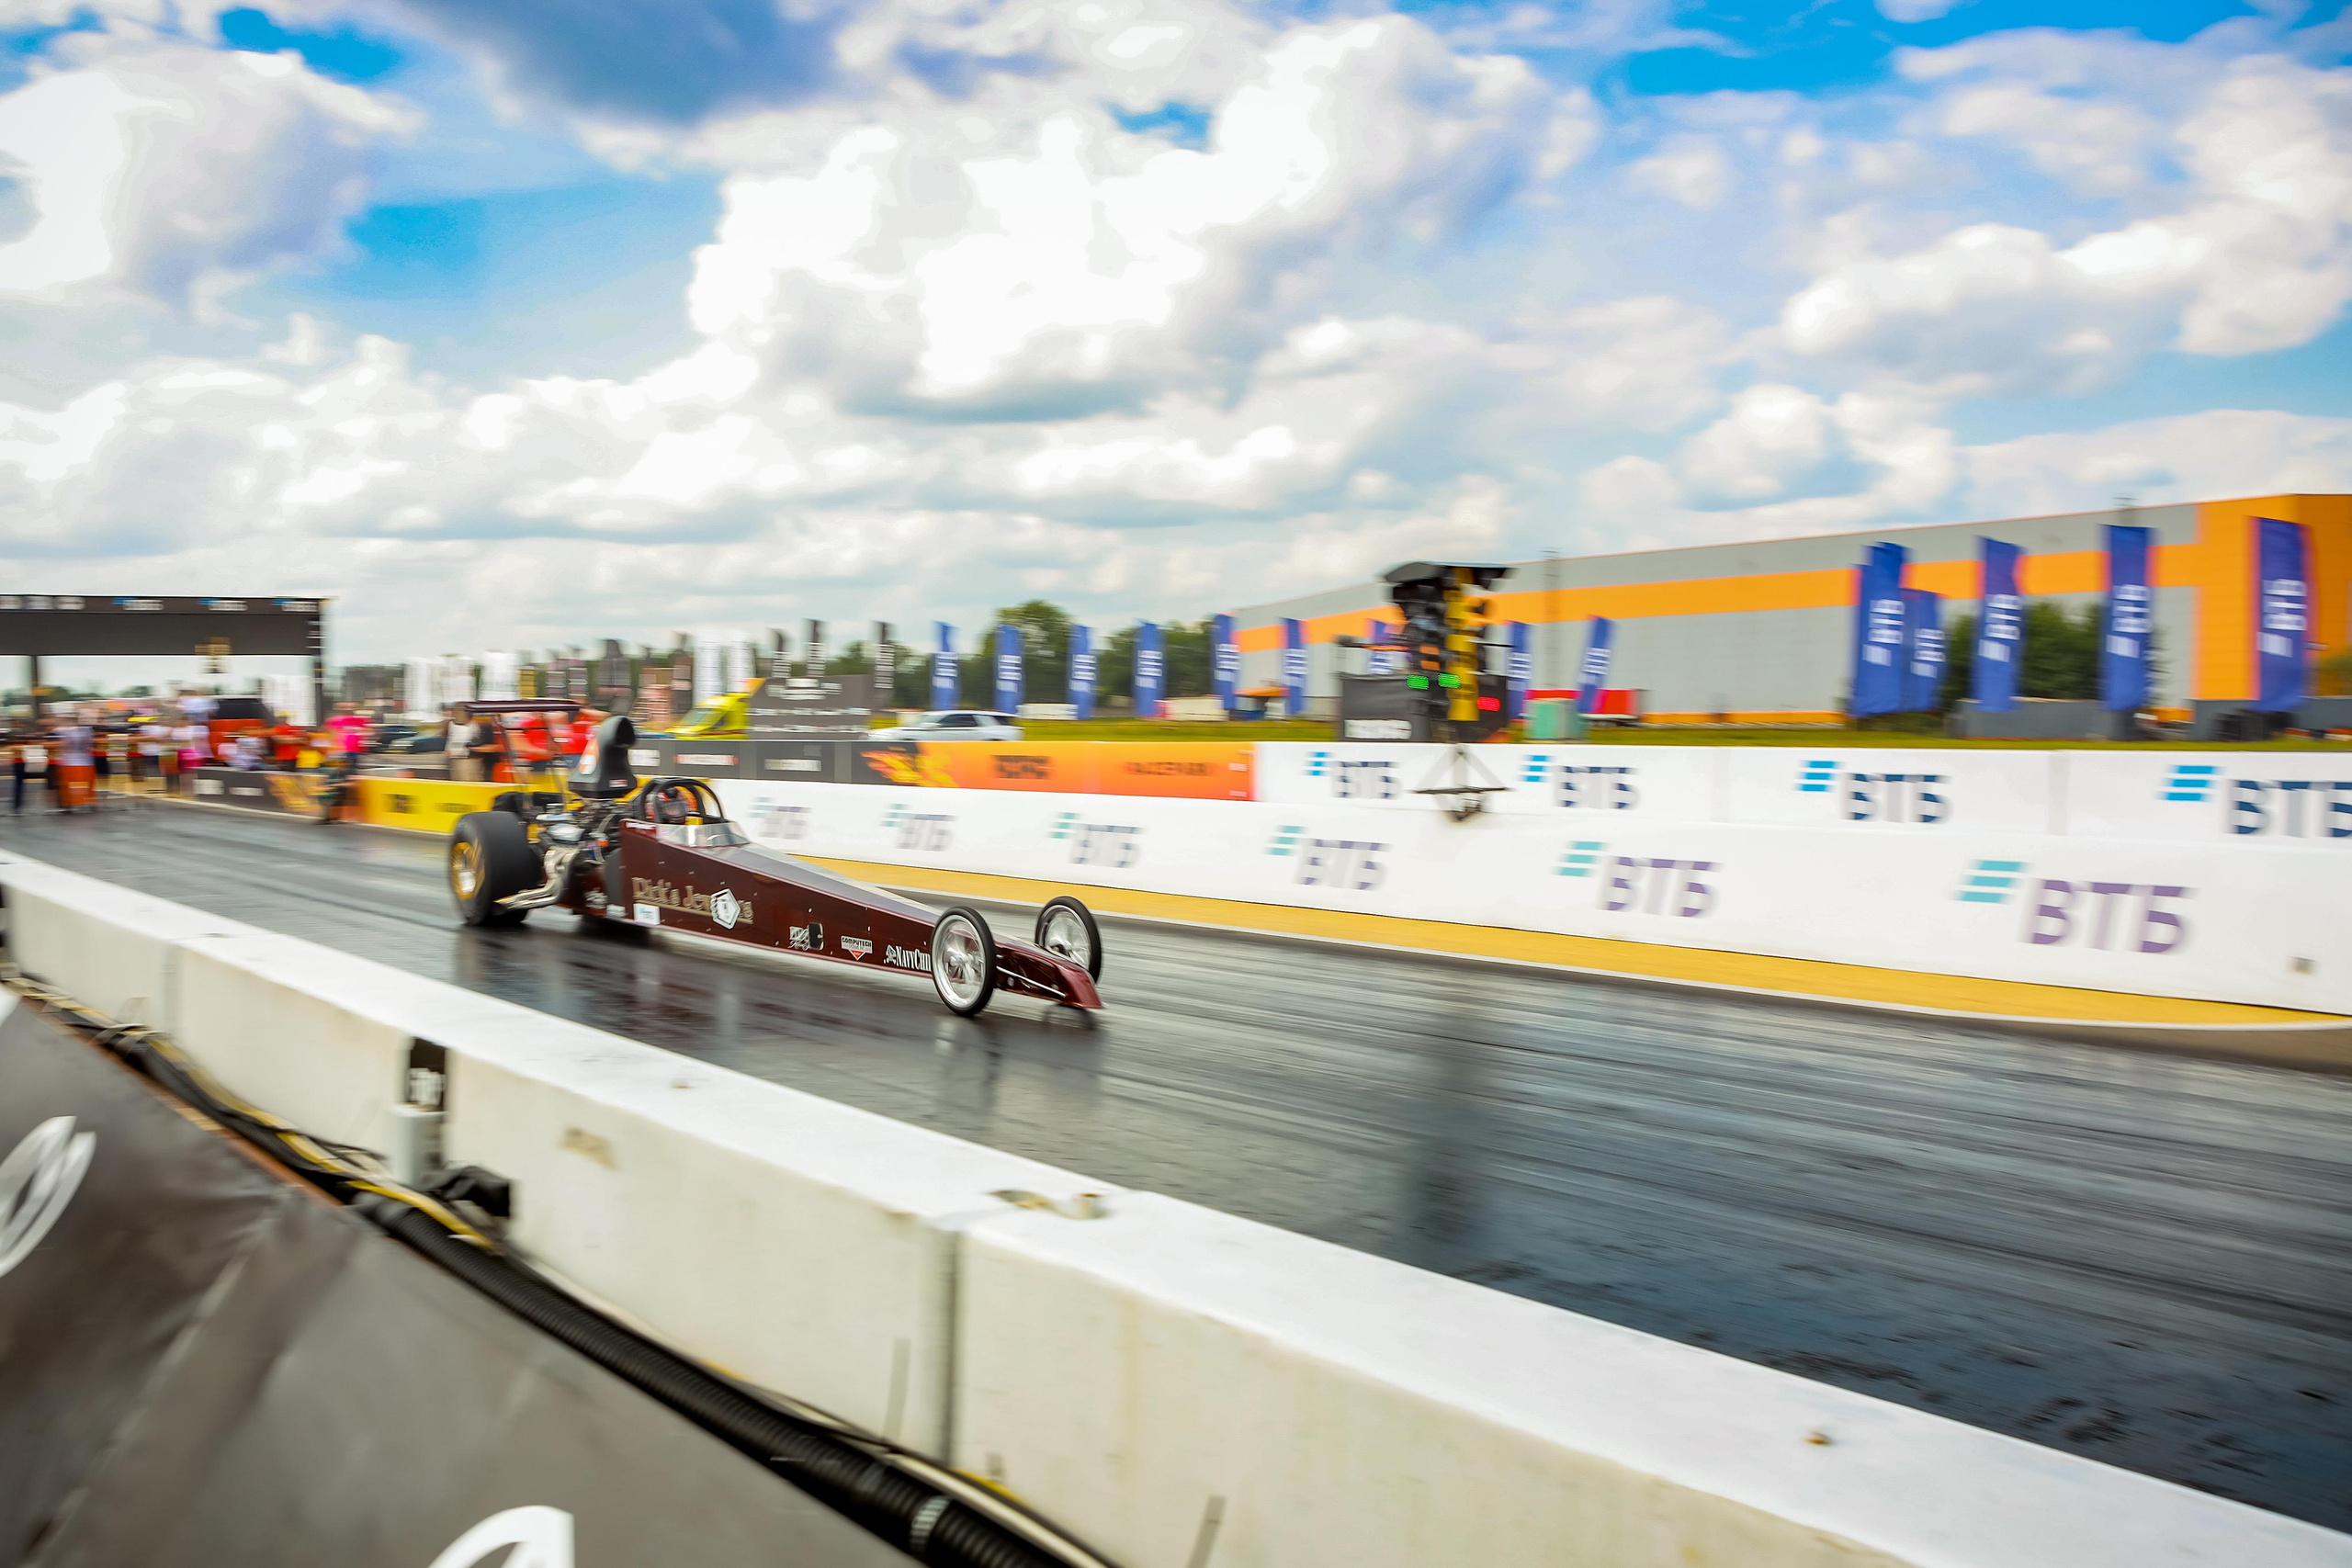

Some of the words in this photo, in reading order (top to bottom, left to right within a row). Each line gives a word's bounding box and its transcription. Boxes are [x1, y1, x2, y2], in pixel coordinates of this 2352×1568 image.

[1332, 761, 1401, 799] ВТБ
[1555, 765, 1640, 809] ВТБ
[1842, 773, 1951, 824] ВТБ
[1070, 823, 1142, 868] ВТБ
[1295, 838, 1388, 890] ВТБ
[1600, 856, 1720, 918] ВТБ
[2029, 878, 2197, 953] ВТБ
[842, 936, 872, 948] COMPUTECH
